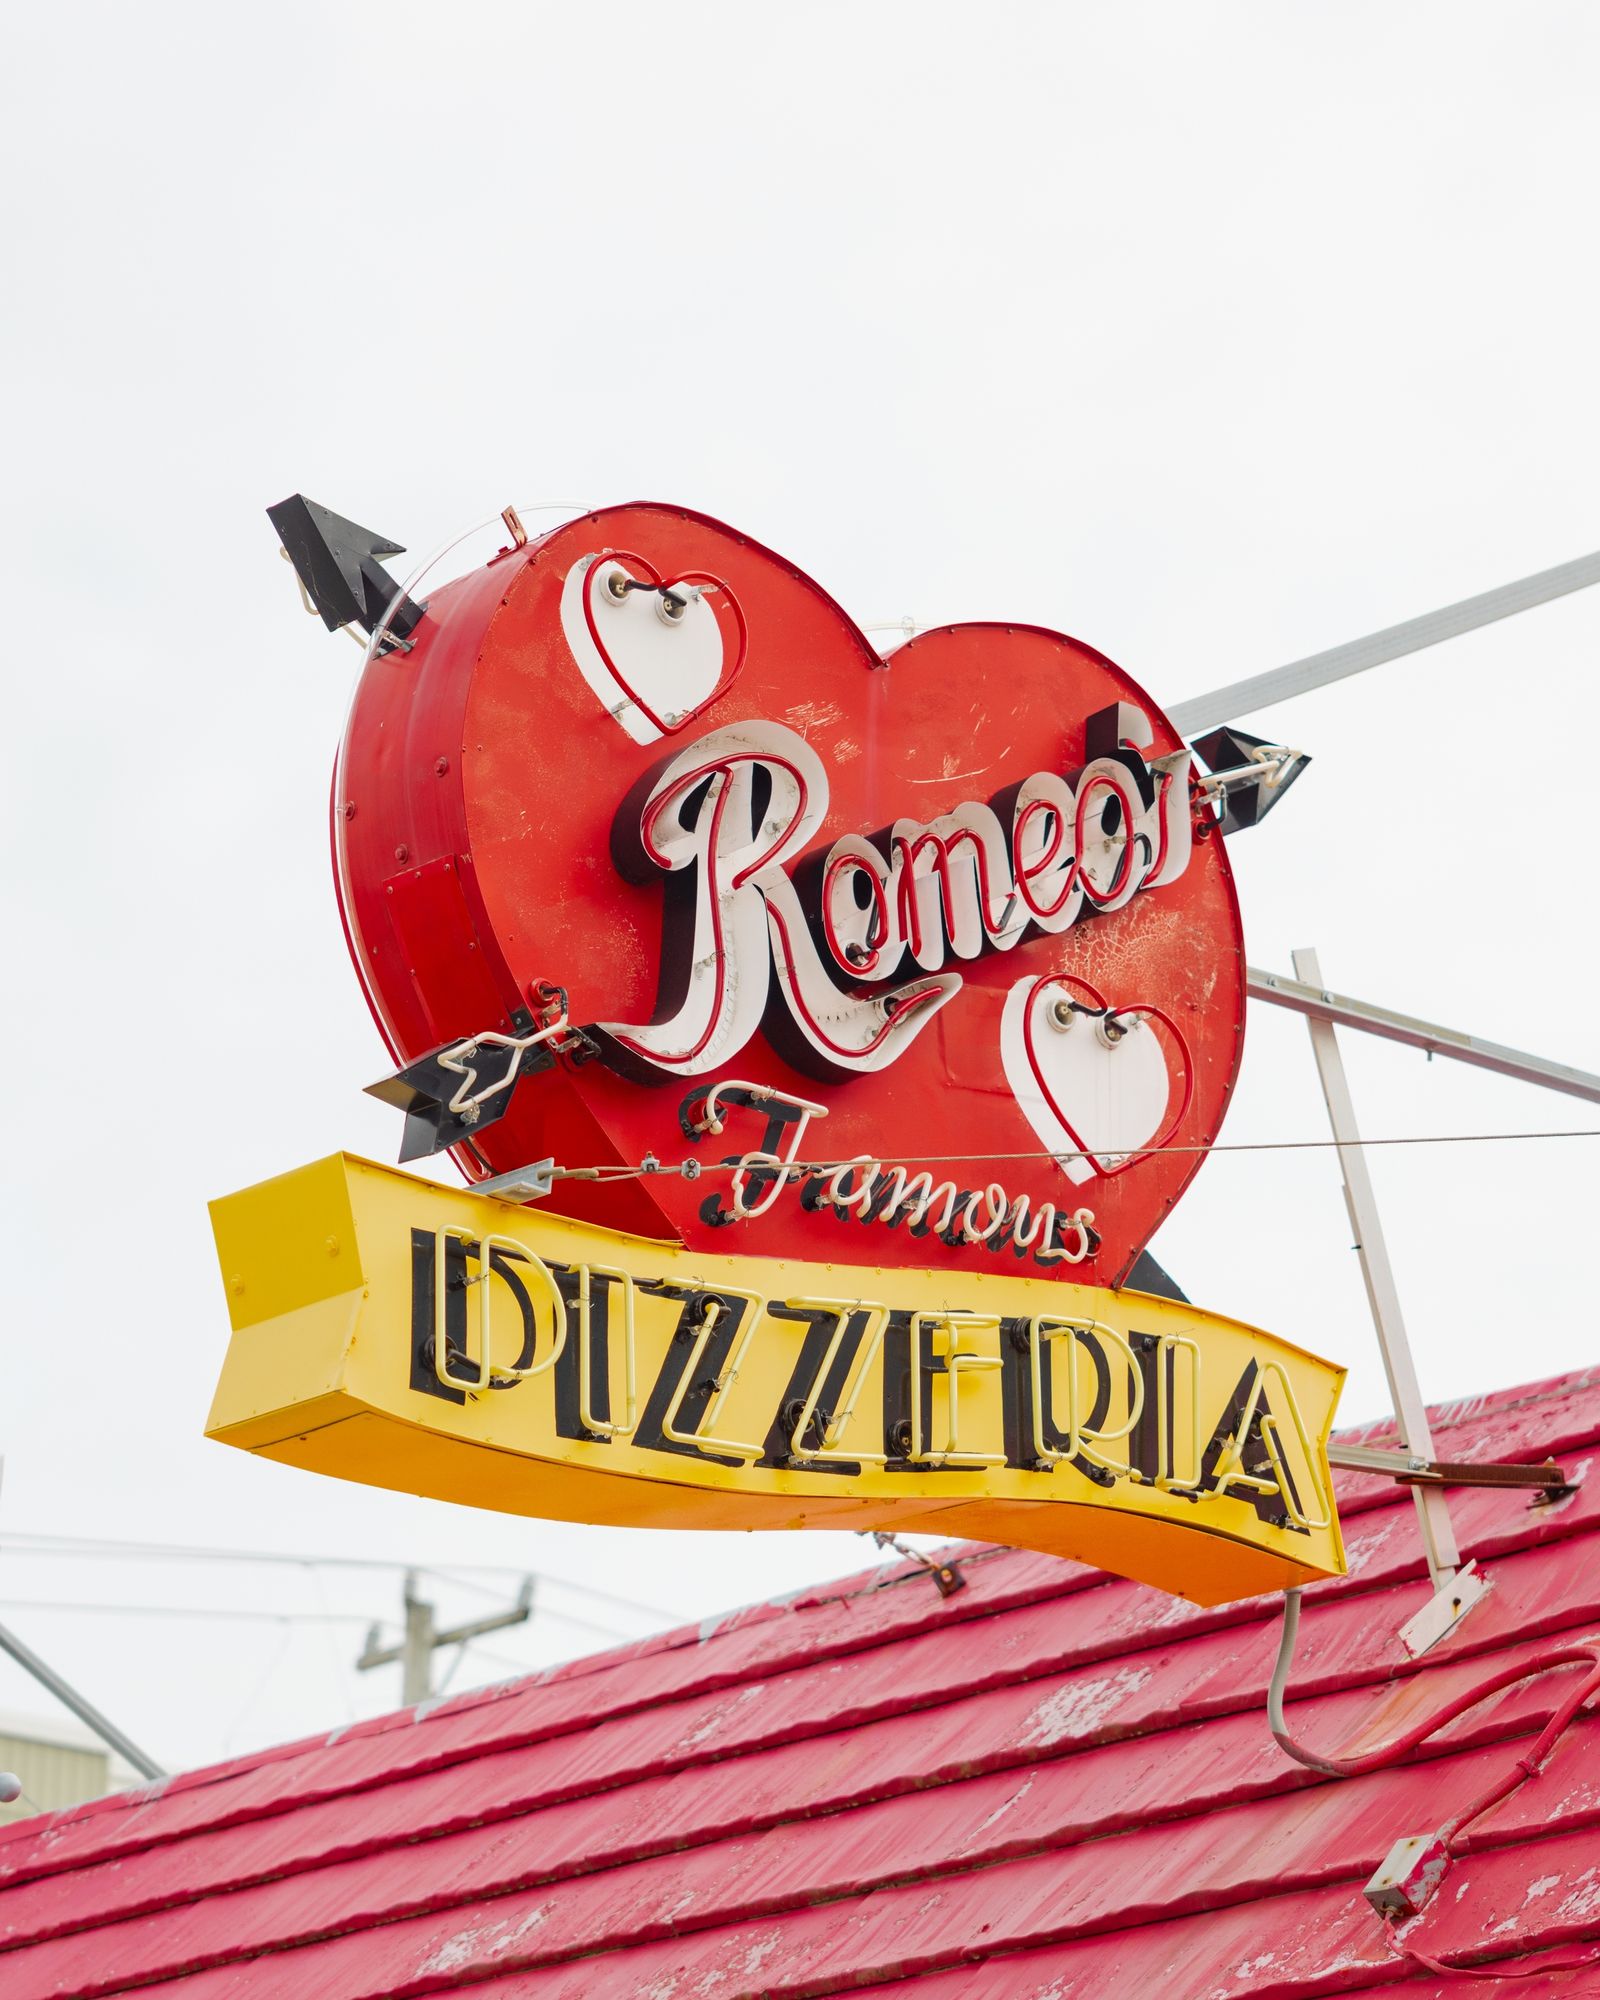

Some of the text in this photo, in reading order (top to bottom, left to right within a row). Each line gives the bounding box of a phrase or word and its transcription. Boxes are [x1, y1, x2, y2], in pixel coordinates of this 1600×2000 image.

[591, 702, 1192, 1080] Romeo's
[678, 1079, 1101, 1266] Famous
[409, 1223, 1331, 1536] PIZZERIA
